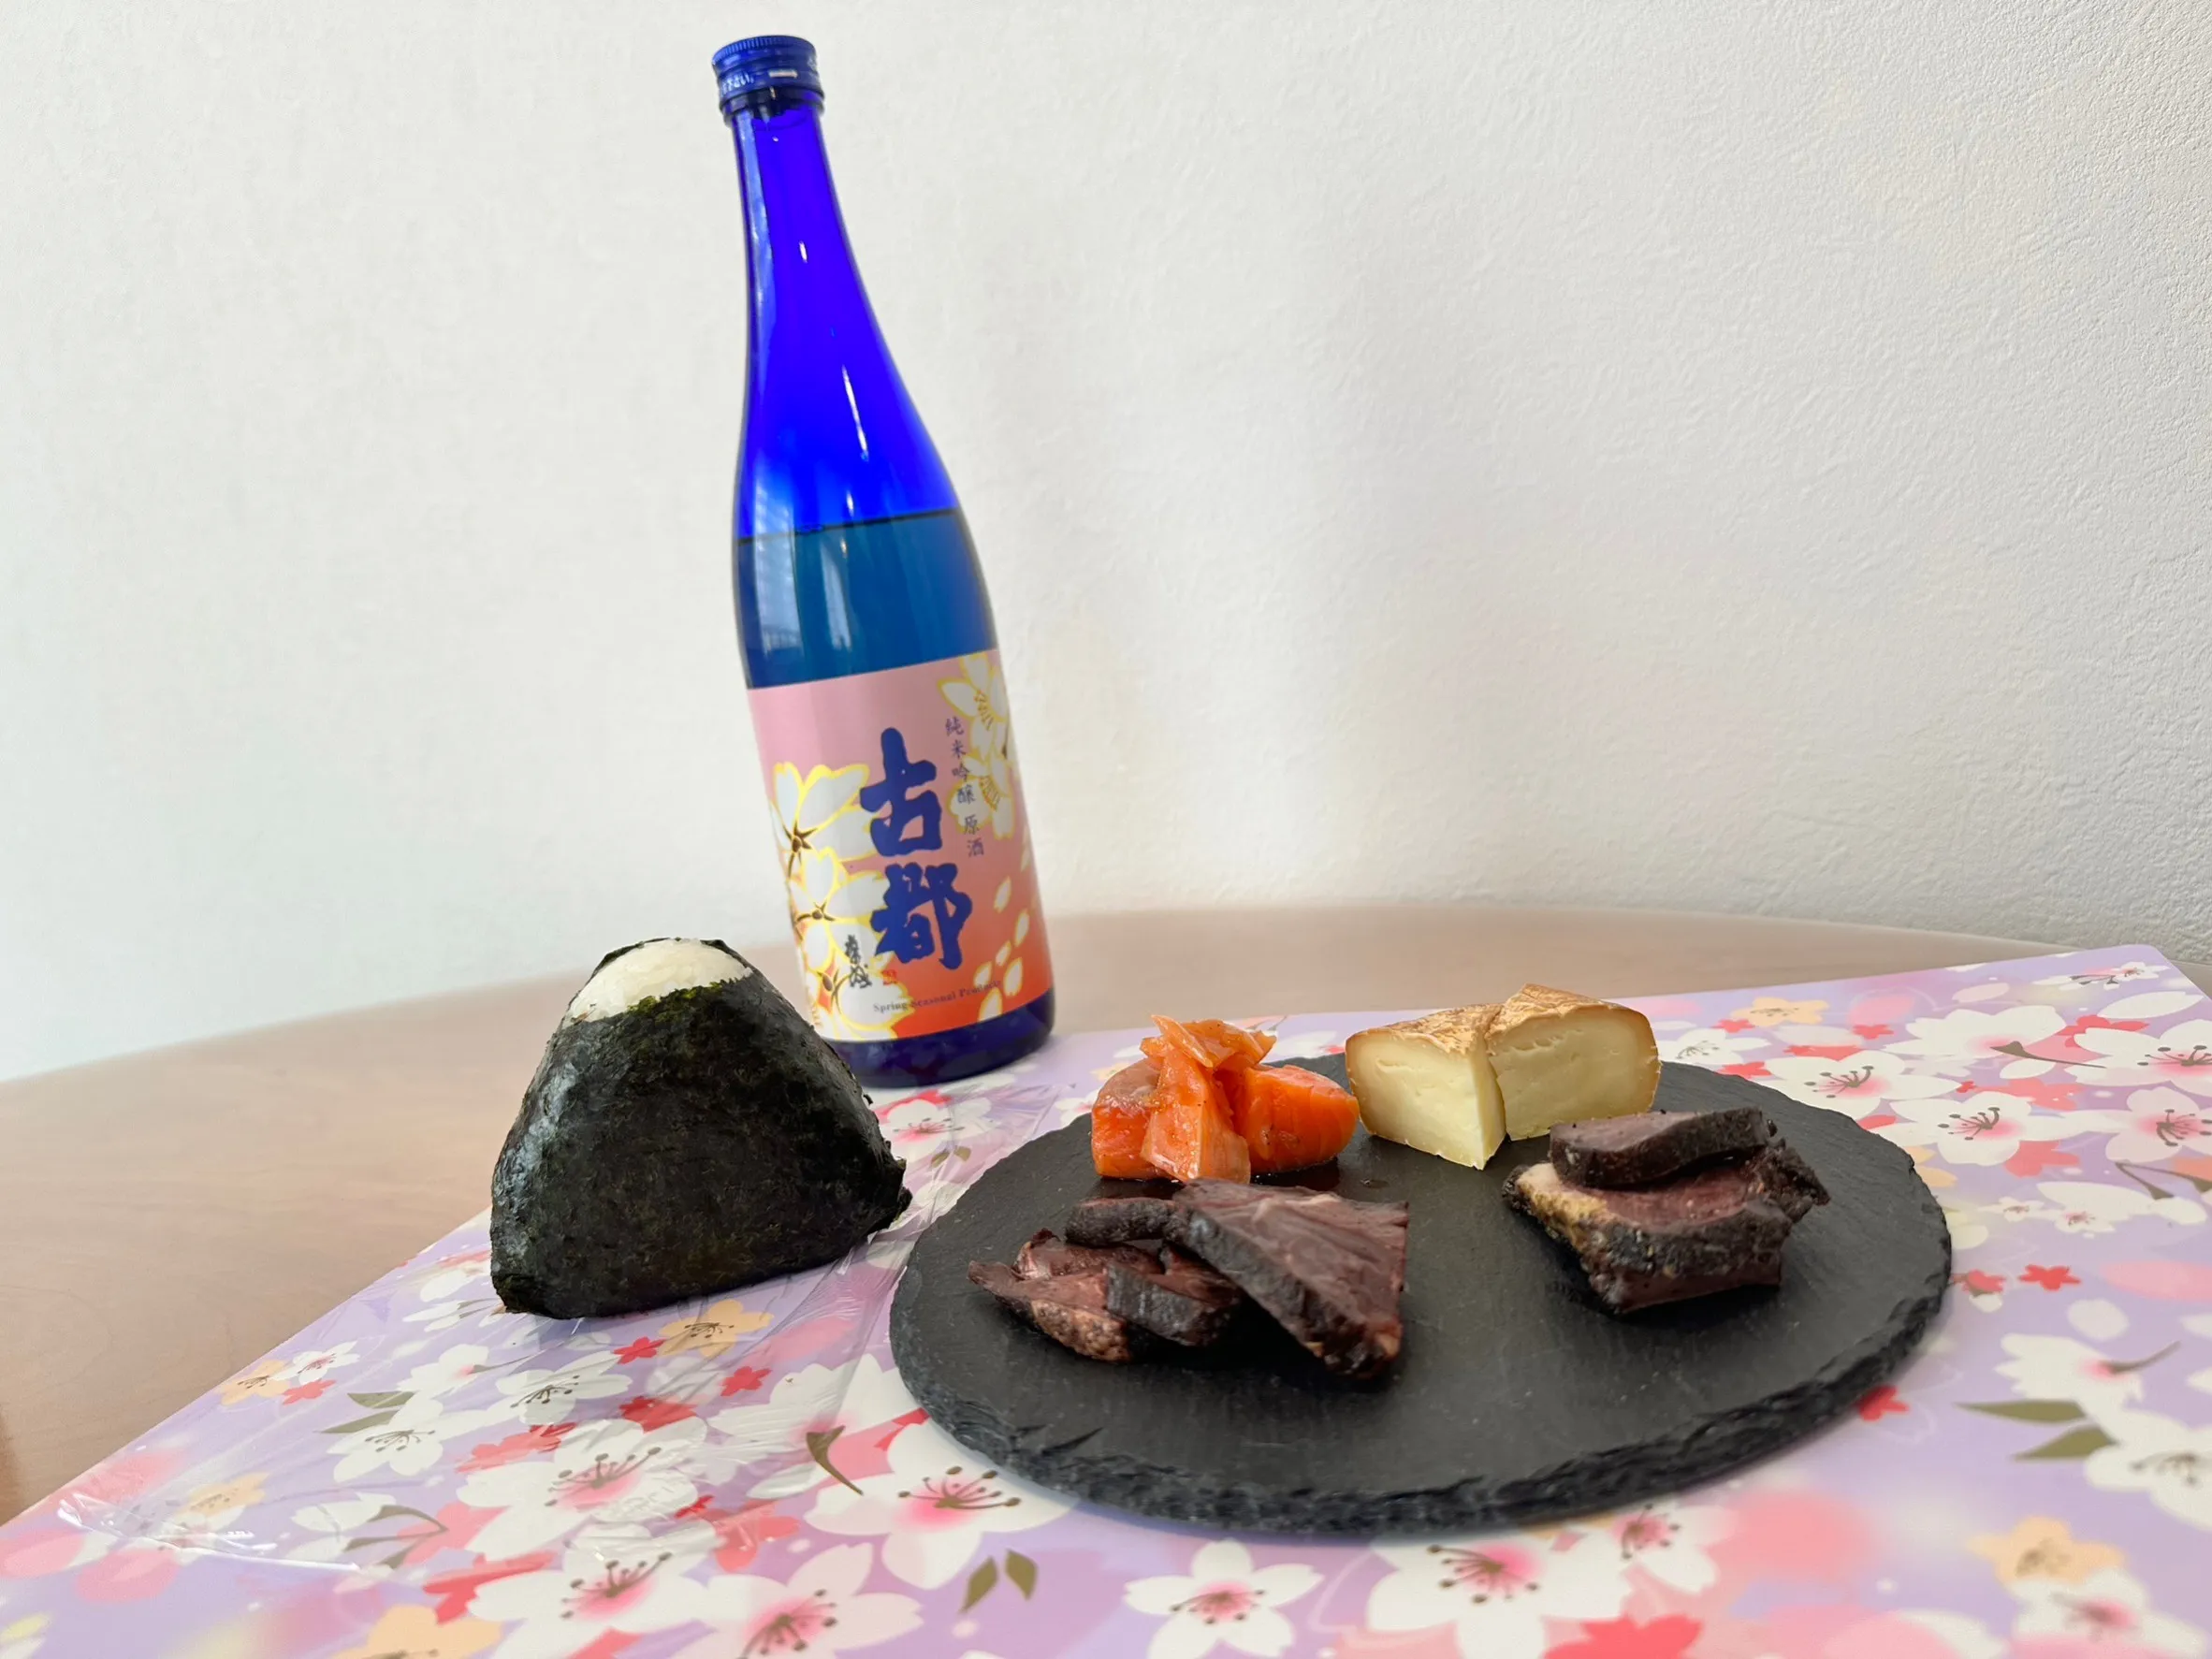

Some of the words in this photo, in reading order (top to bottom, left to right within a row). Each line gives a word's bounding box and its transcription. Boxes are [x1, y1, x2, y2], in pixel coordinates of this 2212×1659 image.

[859, 726, 973, 970] 古都
[964, 813, 984, 858] 原酒
[873, 1000, 909, 1014] Spring
[910, 990, 956, 1009] Seasonal
